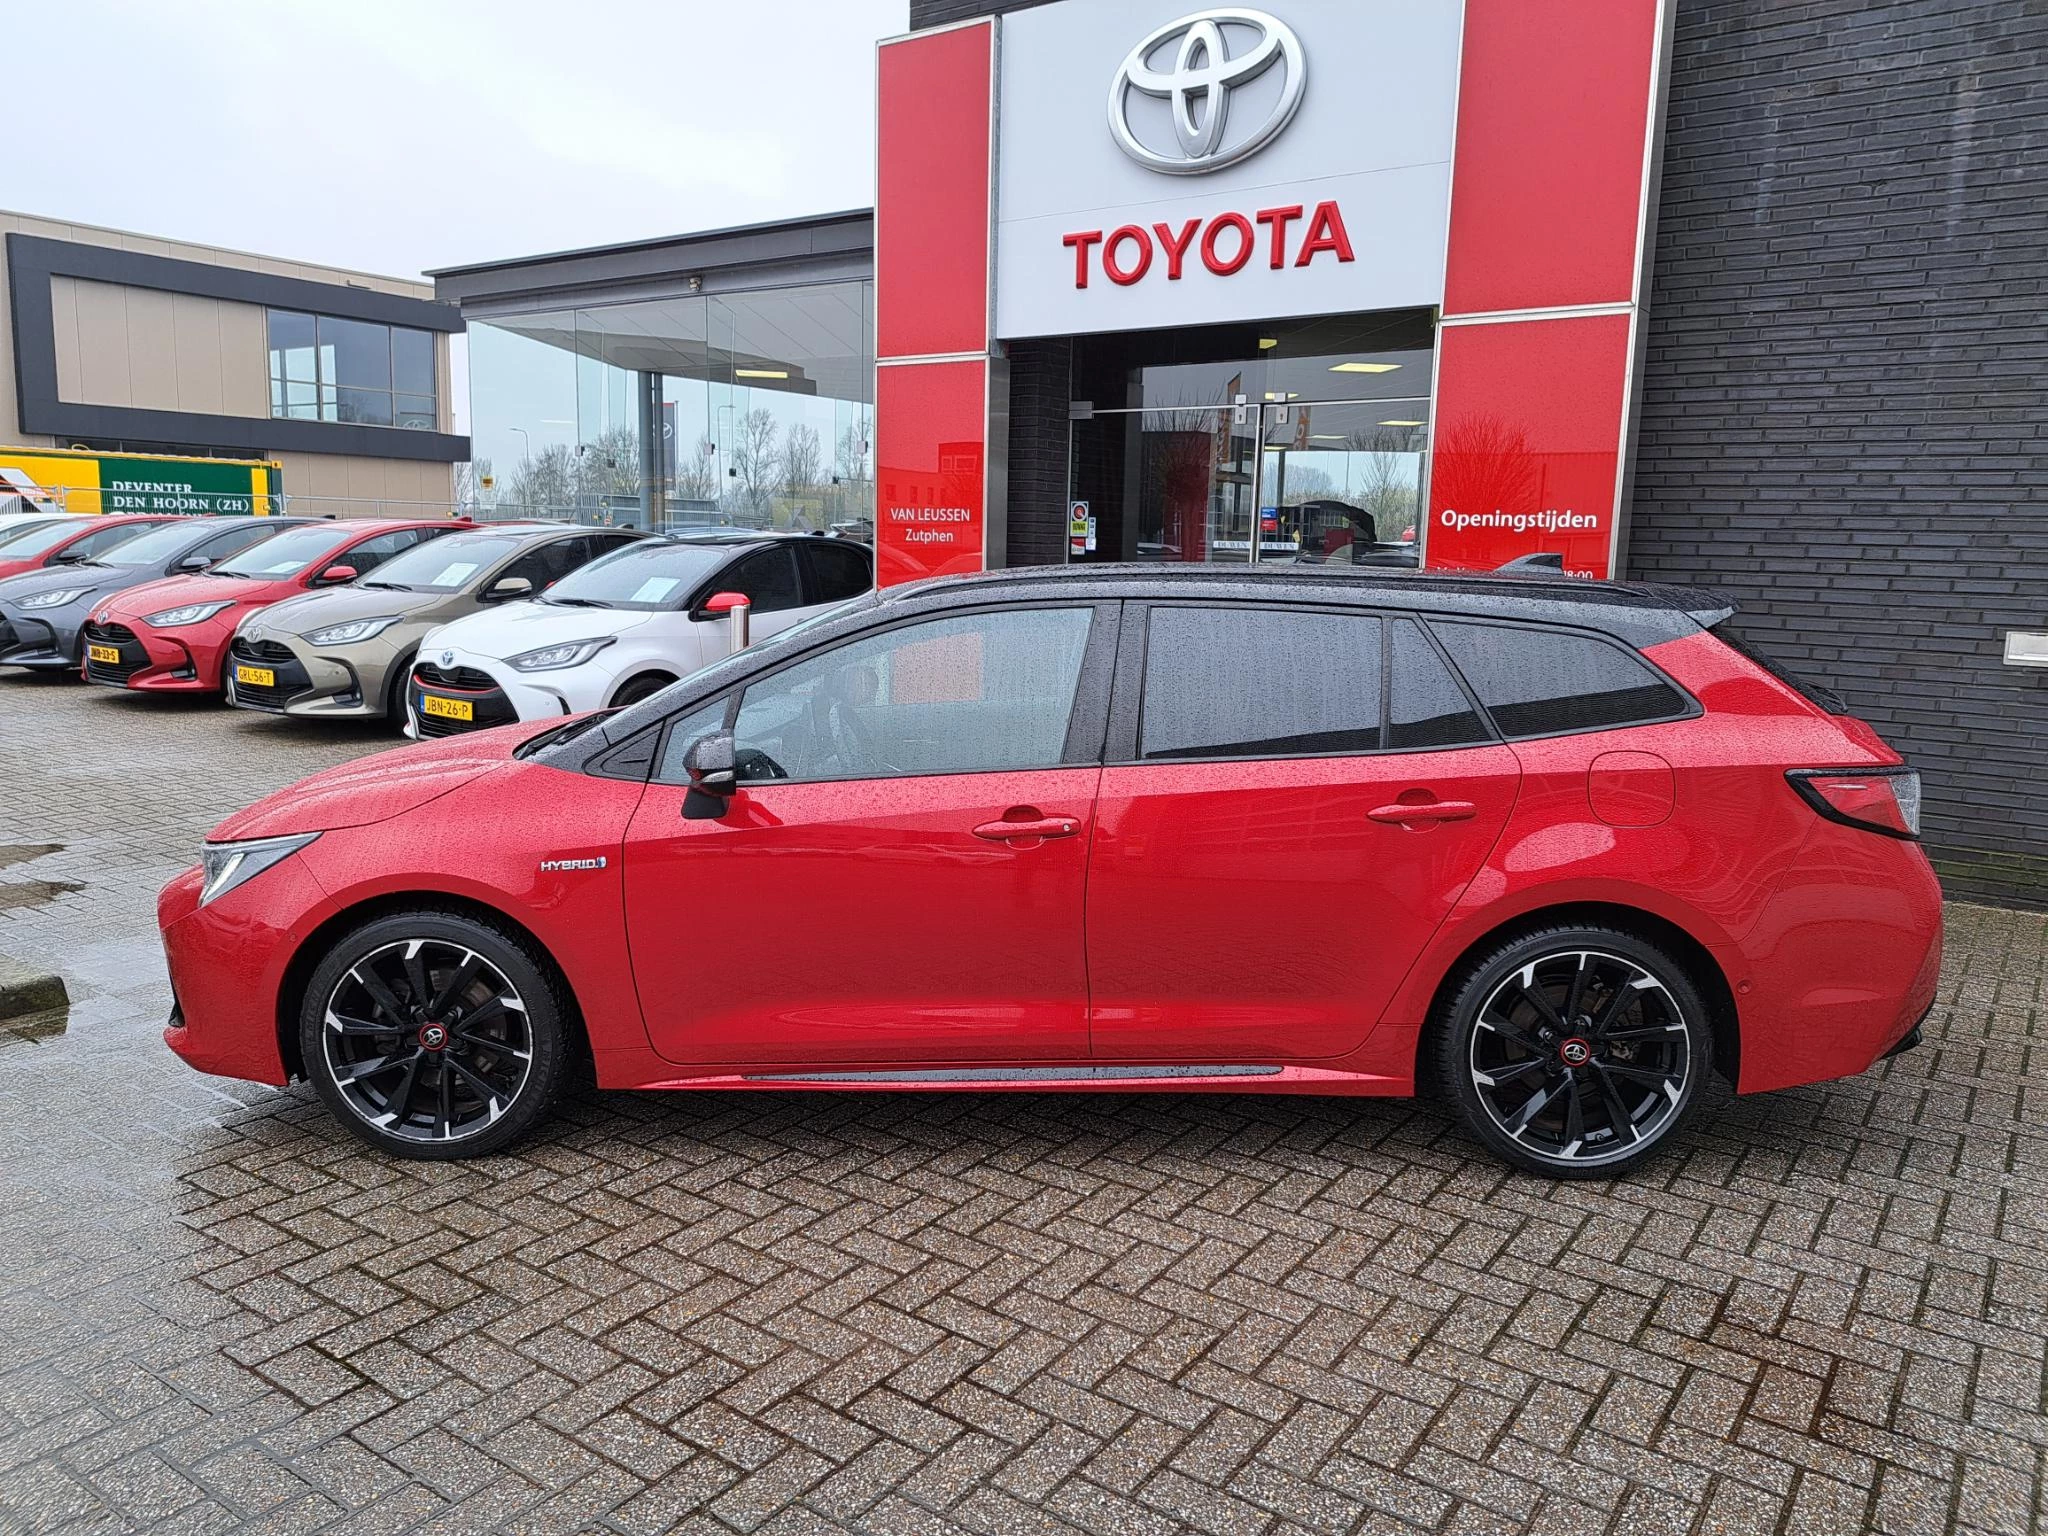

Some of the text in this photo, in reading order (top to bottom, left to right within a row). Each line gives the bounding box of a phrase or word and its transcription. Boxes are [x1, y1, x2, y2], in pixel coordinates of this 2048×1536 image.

[1063, 200, 1355, 288] TOYOTA
[112, 480, 192, 493] DEVENTER
[113, 496, 249, 511] DEN HOORN (ZH)
[890, 507, 970, 521] VAN LEUSSEN
[1441, 510, 1597, 533] Openingstijden
[905, 528, 954, 544] Zutphen
[426, 698, 469, 717] JBN-26-P
[541, 859, 596, 871] HYBRID
